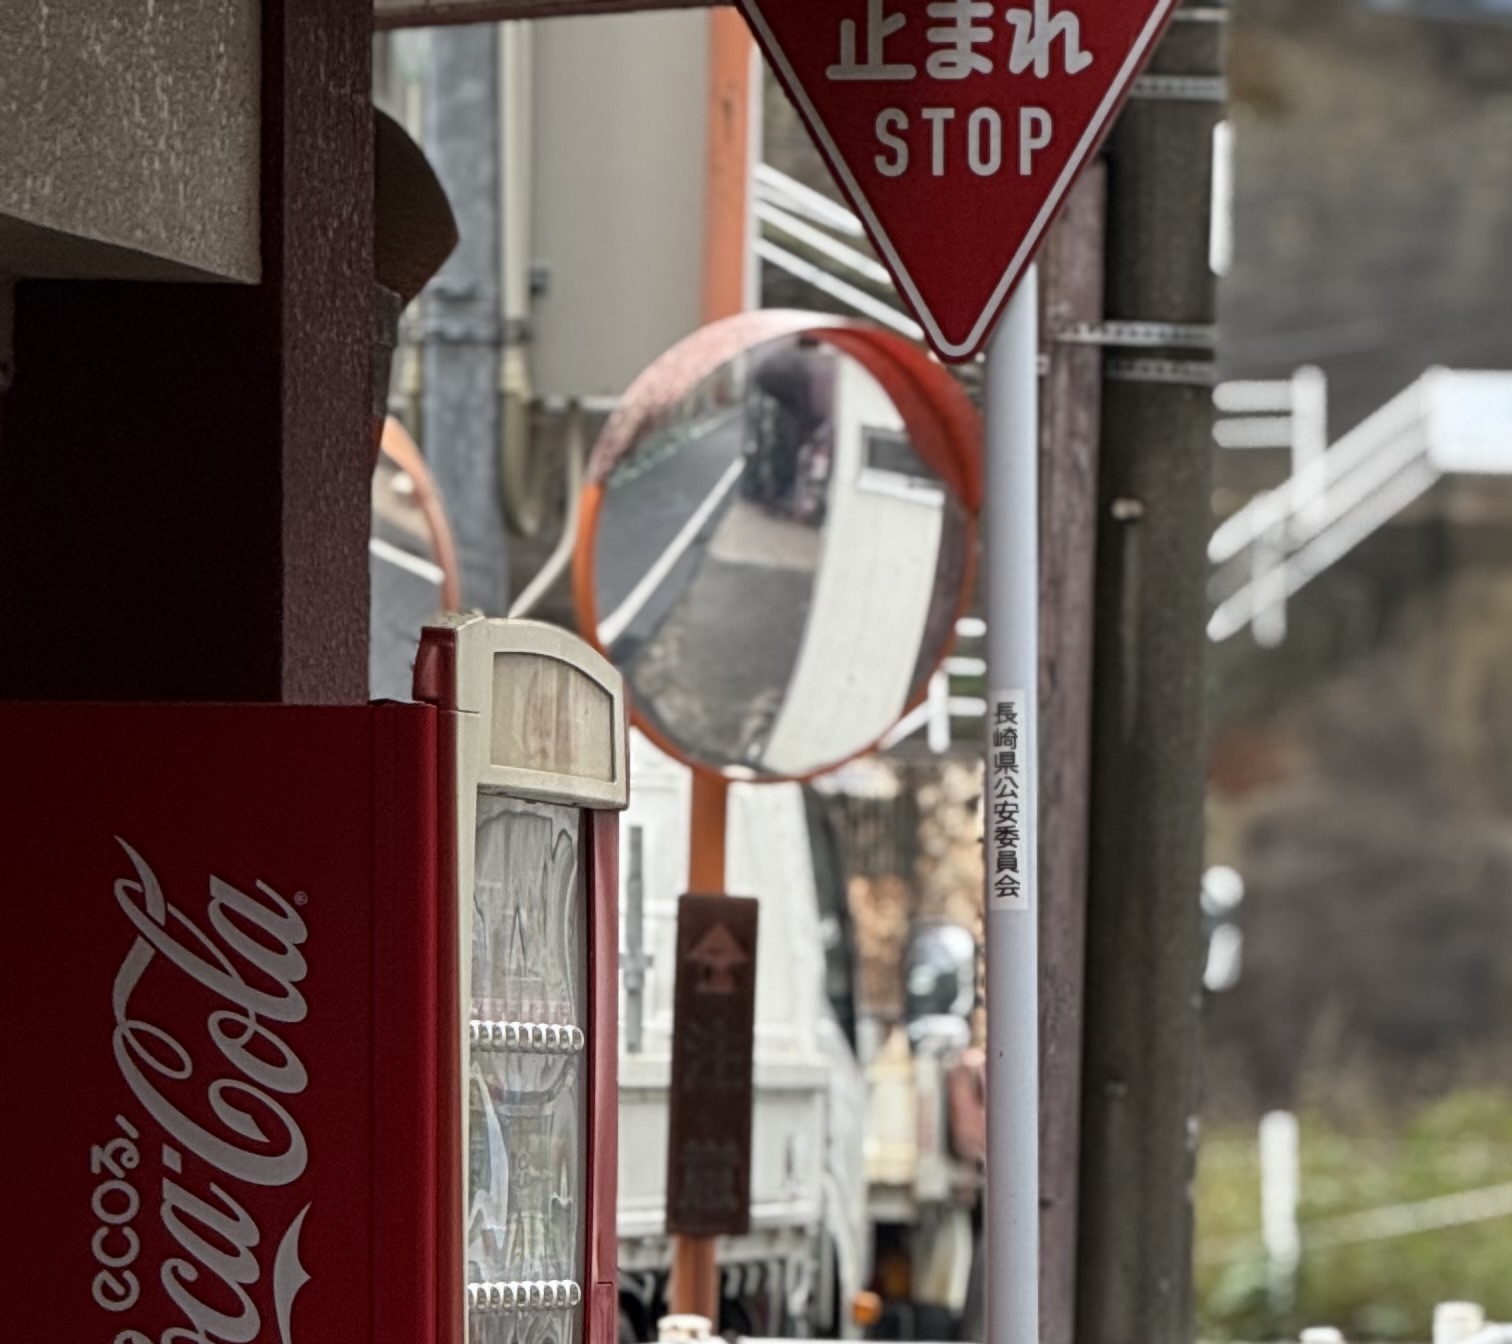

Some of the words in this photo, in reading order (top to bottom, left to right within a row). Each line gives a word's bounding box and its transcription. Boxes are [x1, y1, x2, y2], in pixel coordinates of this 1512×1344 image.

[825, 0, 1093, 80] 止まれ
[874, 106, 1053, 177] STOP
[993, 701, 1021, 898] 長崎県公安委員会
